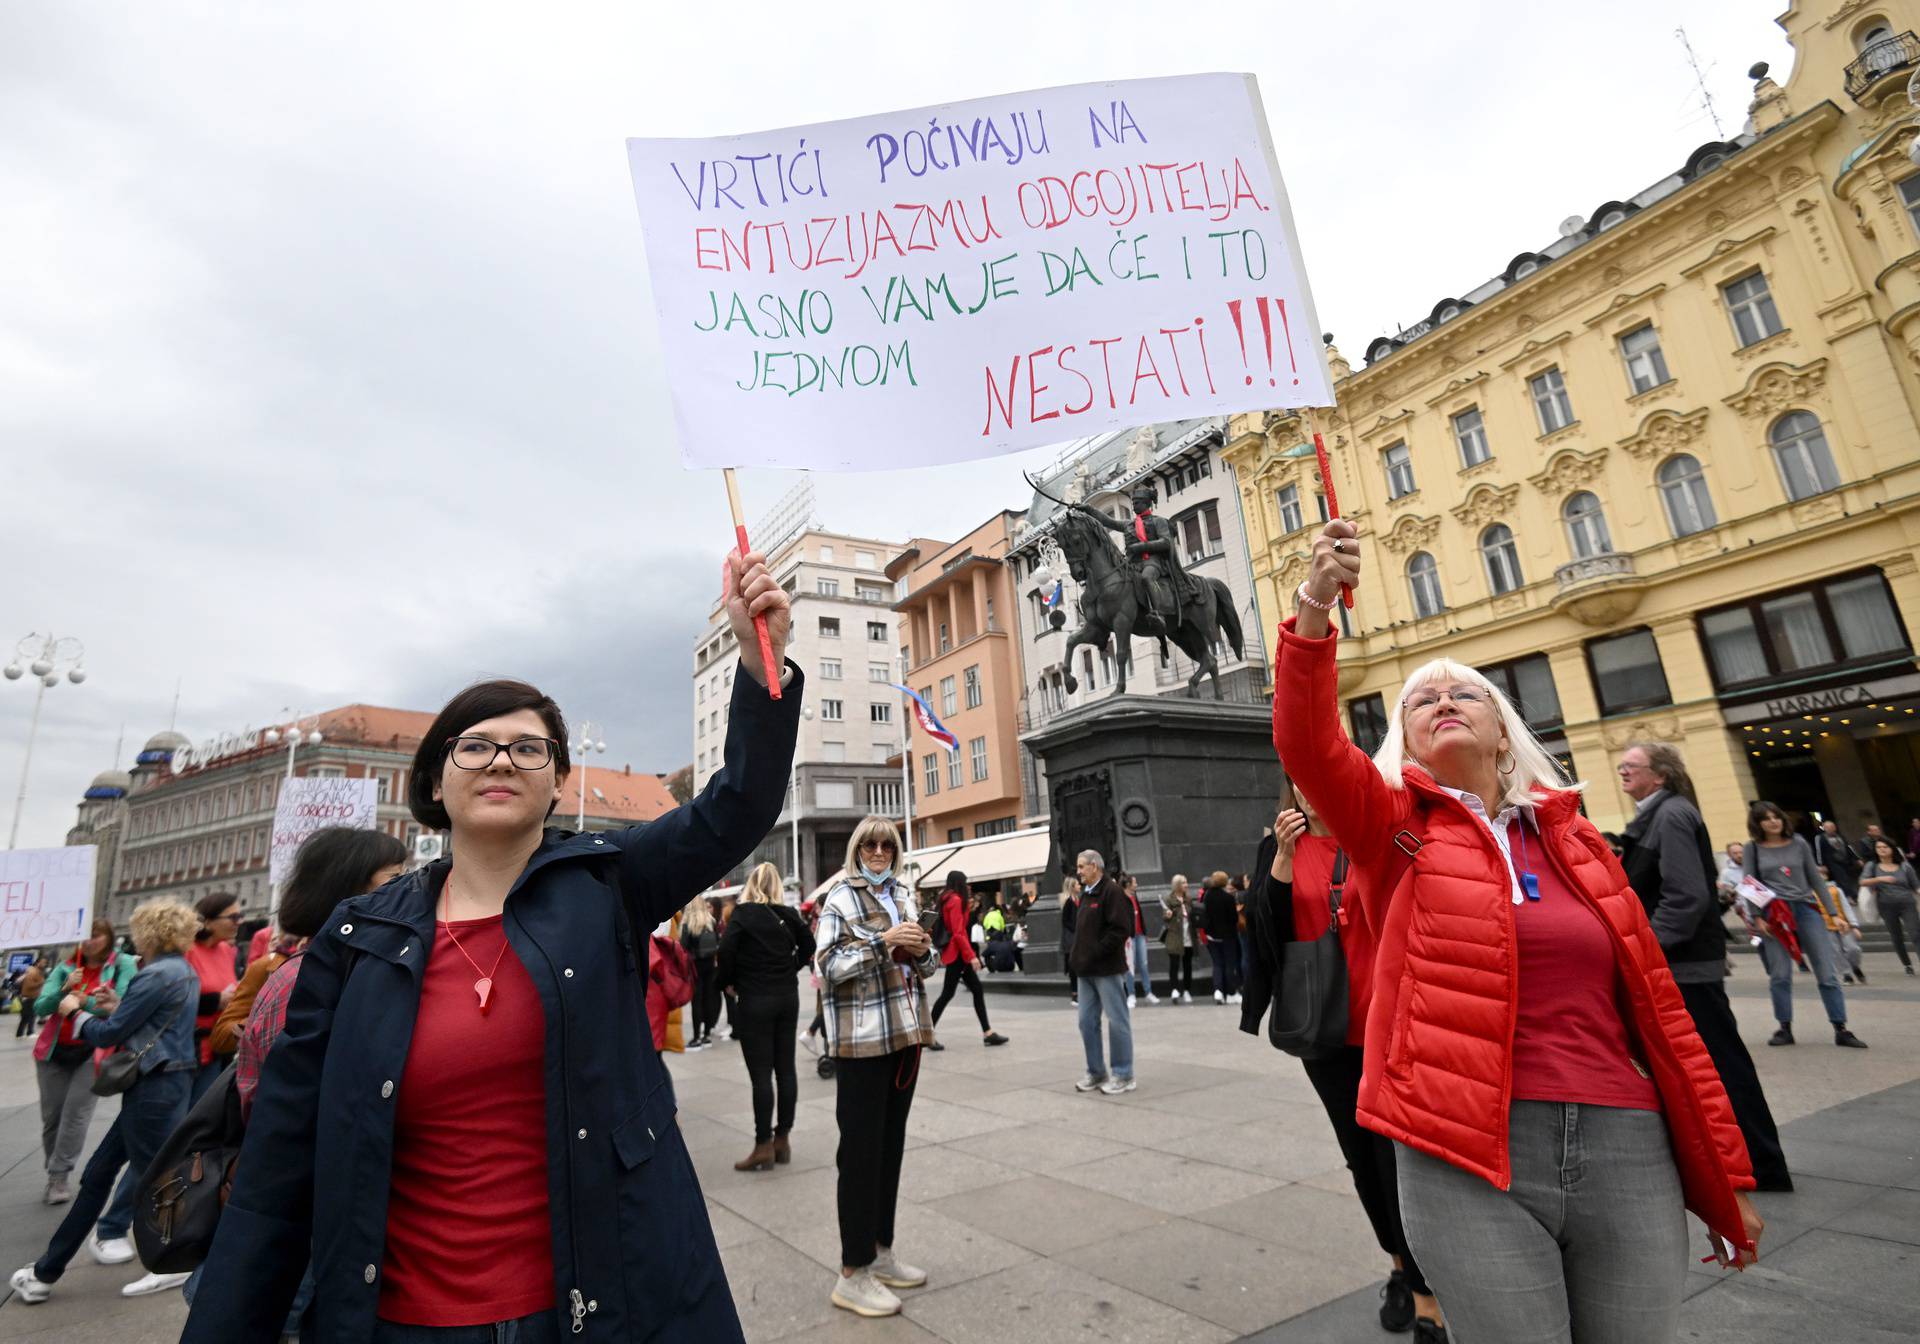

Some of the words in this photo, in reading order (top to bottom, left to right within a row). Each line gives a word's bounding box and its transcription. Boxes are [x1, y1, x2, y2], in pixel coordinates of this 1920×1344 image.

[671, 139, 829, 211] VRTIĆI
[866, 109, 1050, 183] POČIVAJU
[1089, 101, 1149, 150] NA
[696, 196, 1001, 279] ENTUZIJAZMU
[1016, 158, 1270, 227] ODGOJITELJA.
[694, 289, 833, 338] JASNO
[1042, 247, 1103, 297] DA
[1108, 230, 1160, 281] ĆE
[1182, 236, 1193, 281] I
[1208, 230, 1267, 281] TO
[736, 340, 918, 397] JEDNOM
[1766, 686, 1875, 718] HARMICA
